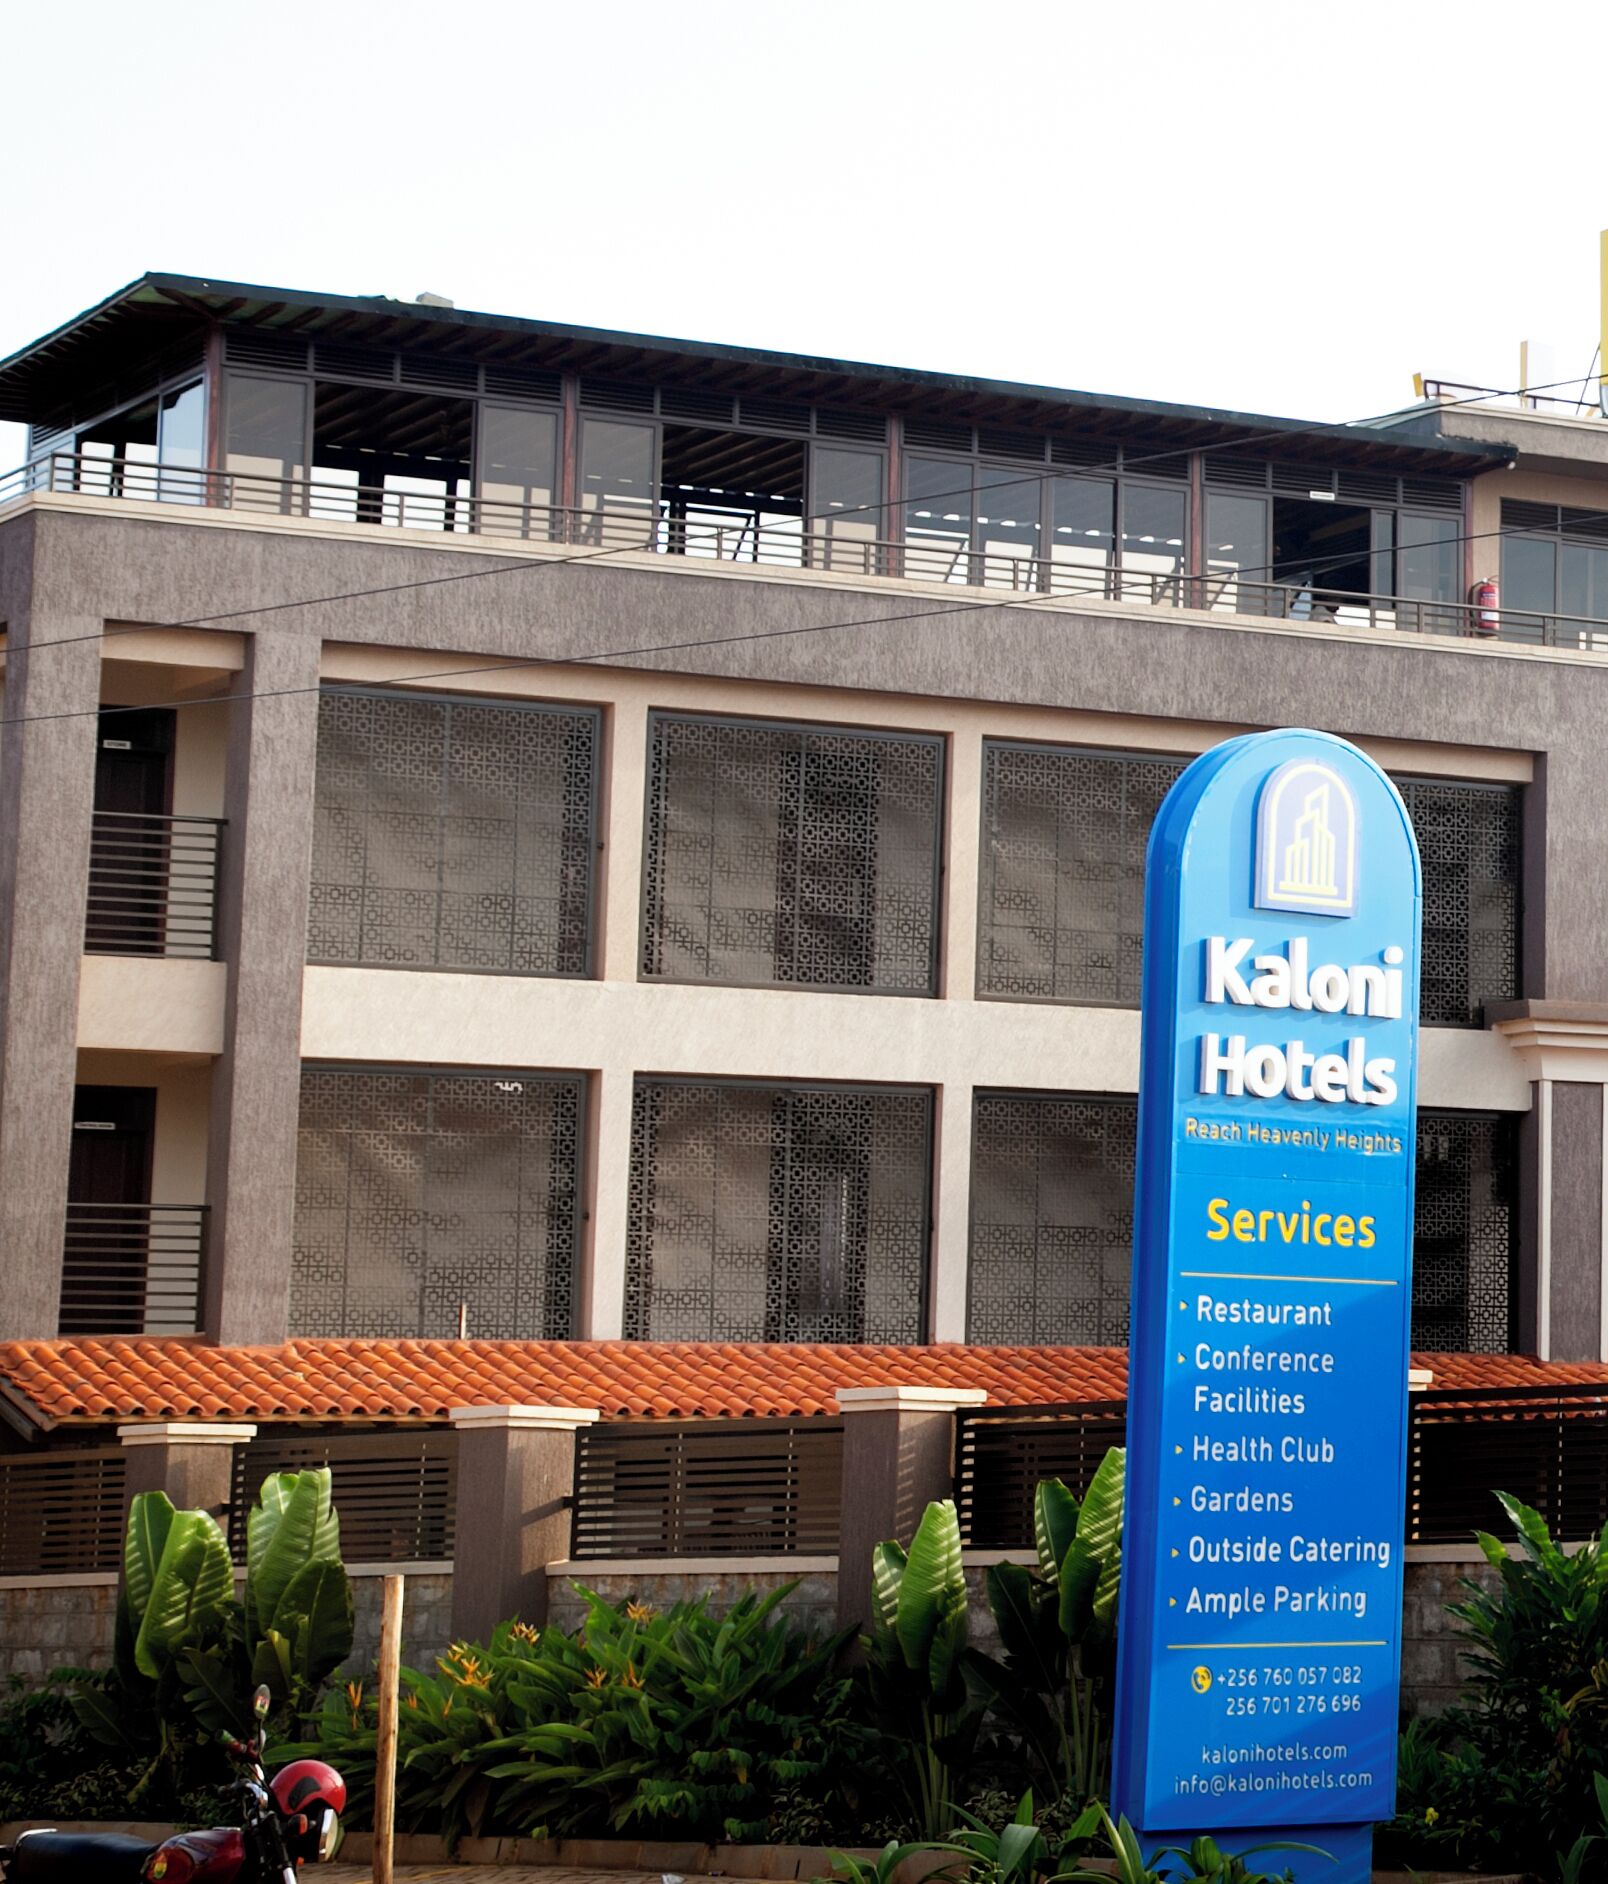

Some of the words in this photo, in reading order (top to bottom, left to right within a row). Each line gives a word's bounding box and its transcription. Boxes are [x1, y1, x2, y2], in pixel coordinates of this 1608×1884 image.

[1205, 936, 1404, 1018] Kaloni
[1201, 1033, 1397, 1105] Hotels
[1185, 1117, 1242, 1139] Reach
[1247, 1121, 1331, 1152] Heavenly
[1335, 1126, 1402, 1156] Heights
[1206, 1198, 1376, 1248] Services
[1197, 1295, 1332, 1326] Restaurant
[1195, 1343, 1334, 1373] Conference
[1194, 1385, 1305, 1414] Facilities
[1193, 1435, 1273, 1462] Health
[1281, 1436, 1334, 1463] Club
[1190, 1485, 1294, 1512] Gardens
[1188, 1535, 1281, 1563] Outside
[1289, 1536, 1391, 1568] Catering
[1185, 1586, 1265, 1619] Ample
[1274, 1585, 1367, 1618] Parking
[1217, 1668, 1258, 1687] +256
[1263, 1667, 1293, 1686] 760
[1297, 1666, 1328, 1685] 057
[1332, 1665, 1362, 1684] 082
[1226, 1697, 1257, 1716] 256
[1262, 1696, 1290, 1714] 701
[1296, 1695, 1327, 1714] 276
[1331, 1694, 1361, 1713] 696
[1202, 1743, 1348, 1764] kalonihotels.com
[1174, 1771, 1372, 1795] info@kalonihotels.com
